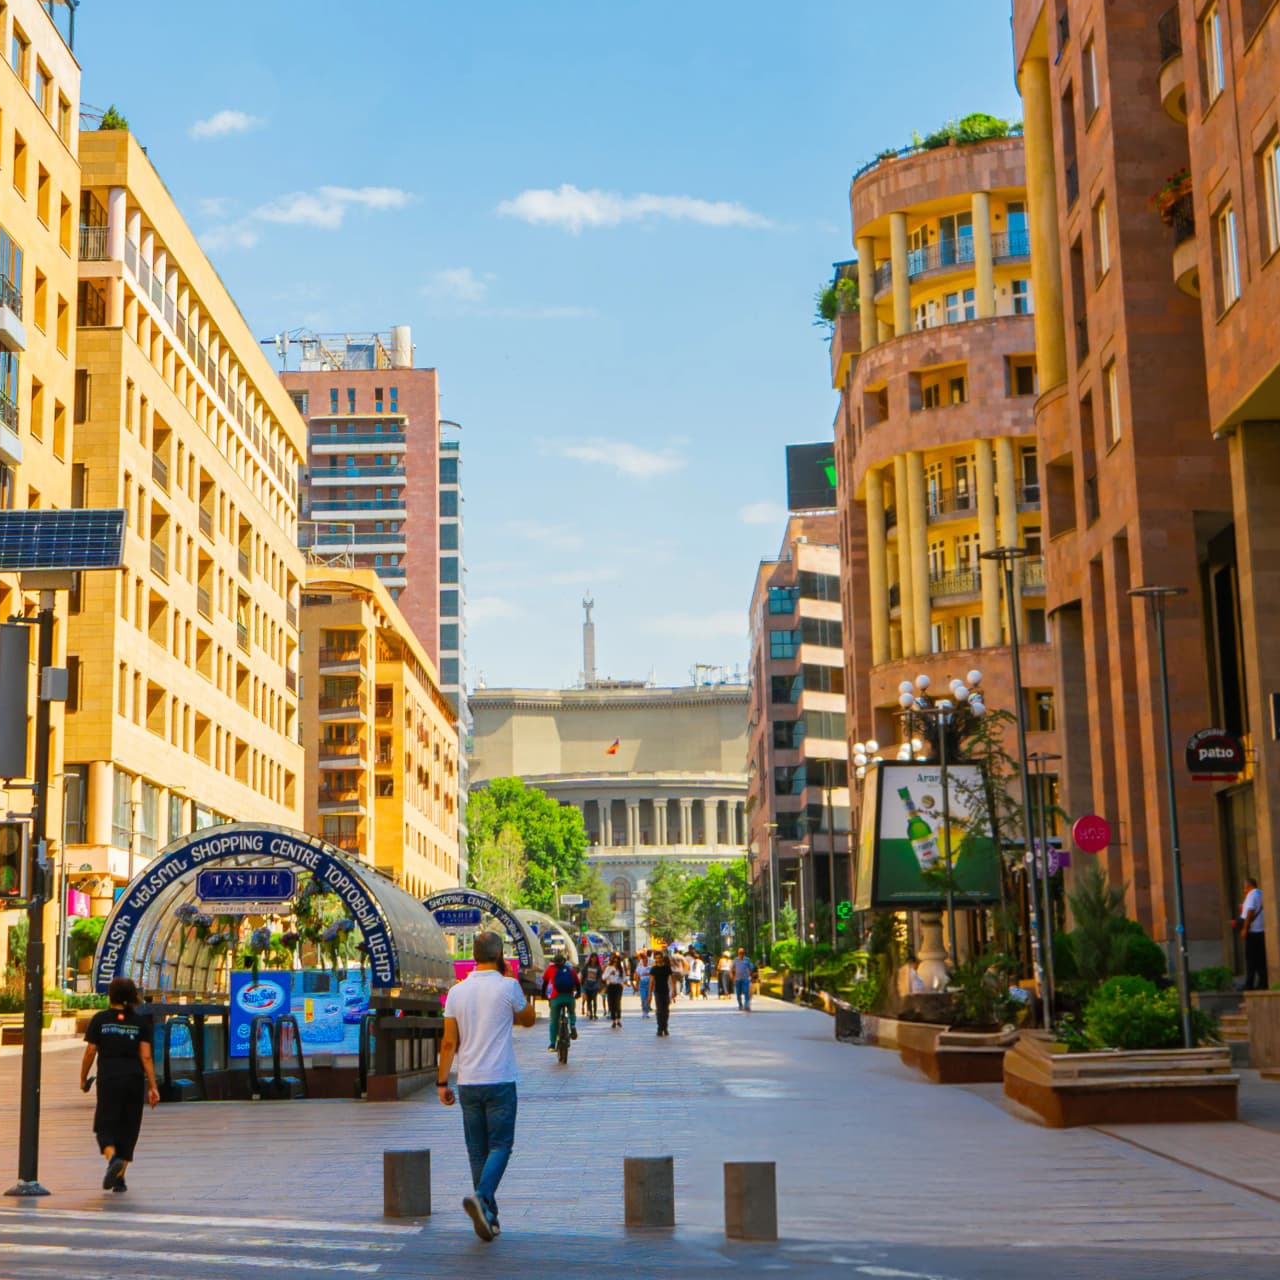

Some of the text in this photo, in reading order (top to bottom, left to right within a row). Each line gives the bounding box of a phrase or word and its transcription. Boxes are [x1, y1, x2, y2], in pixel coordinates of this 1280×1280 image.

[1199, 746, 1234, 761] patio
[191, 836, 322, 869] SHOPPING CENTRE
[129, 859, 188, 908] ԿԵՆՏՐՈՆ
[213, 875, 279, 886] TASHIR
[429, 895, 464, 908] SHOPPING
[324, 863, 391, 982] ТОРГОВЫЙ ЦЕНТР
